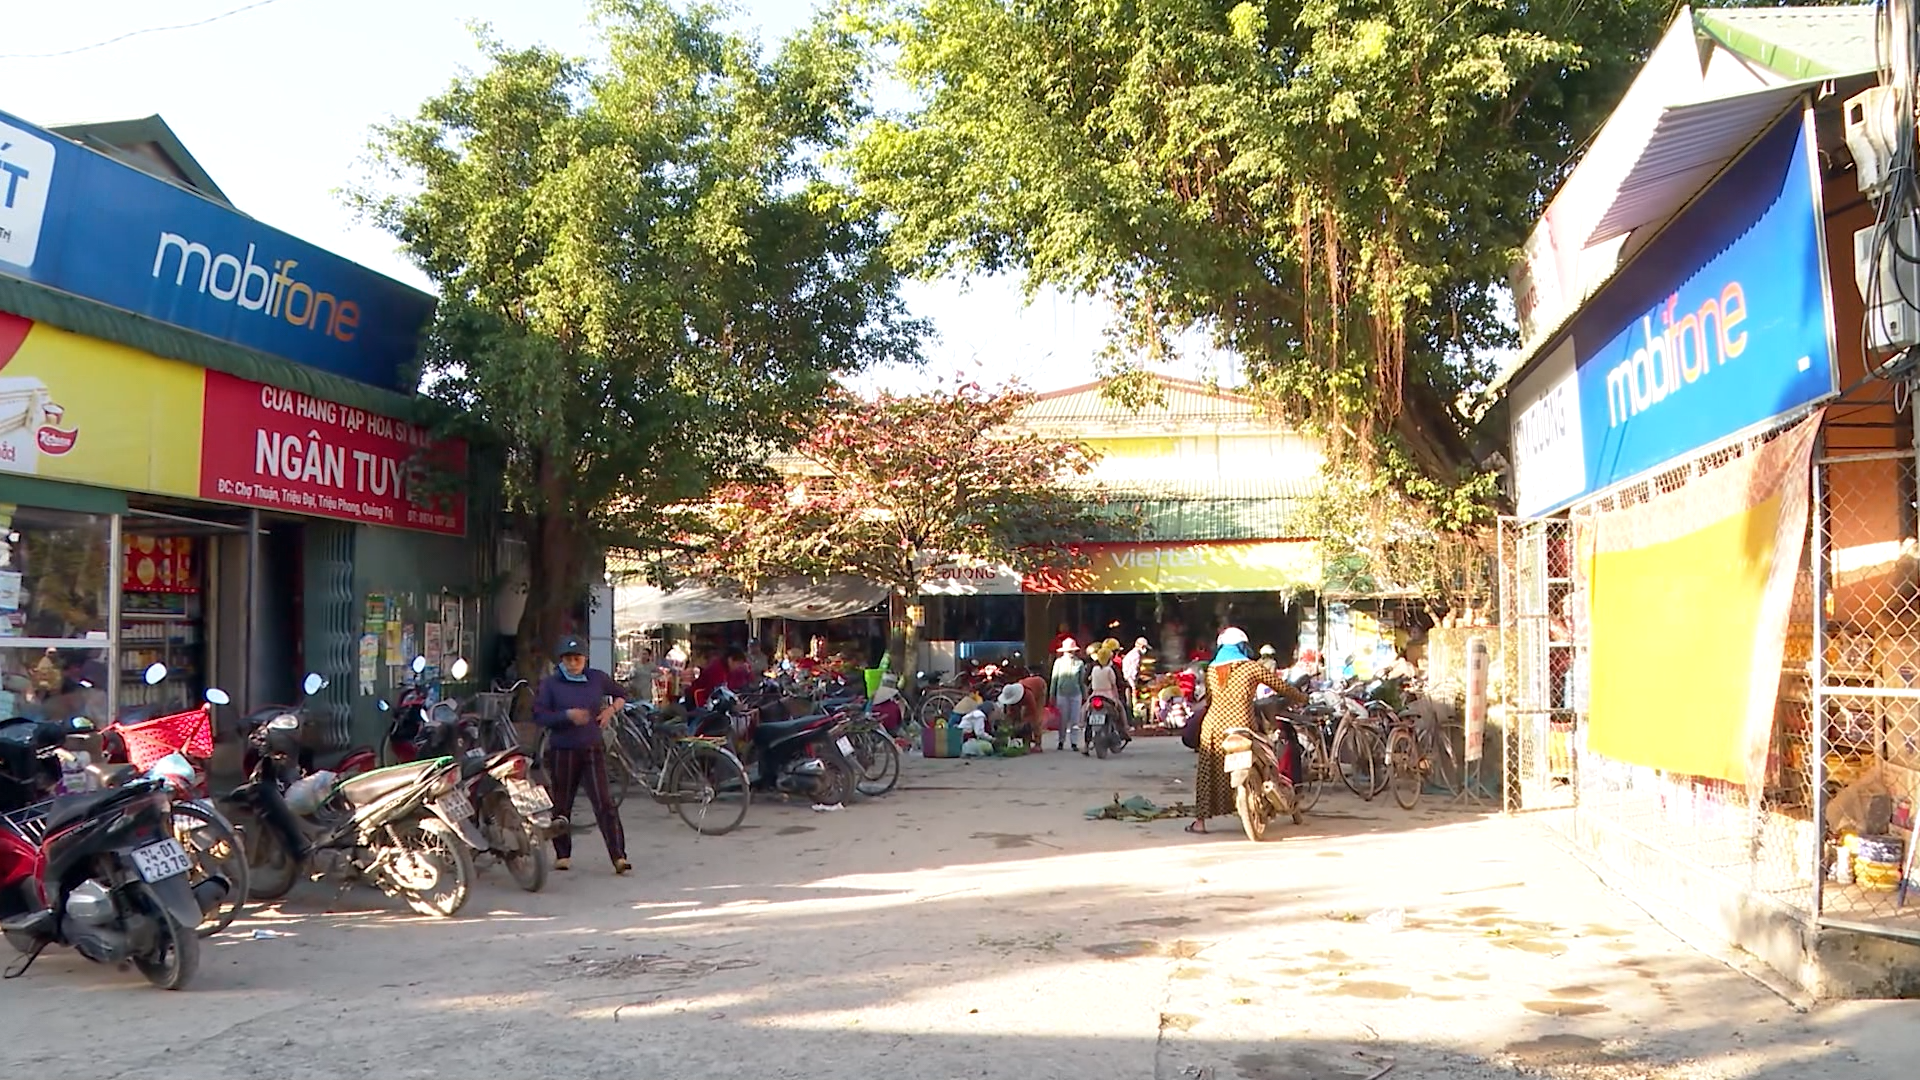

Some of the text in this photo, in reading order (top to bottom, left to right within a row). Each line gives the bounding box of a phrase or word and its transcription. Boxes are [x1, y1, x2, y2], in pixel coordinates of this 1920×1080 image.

[152, 231, 360, 342] mobifone
[1606, 281, 1749, 429] mobifone
[339, 405, 364, 434] TẠP
[218, 478, 234, 494] ĐC:
[235, 481, 252, 499] Chợ
[255, 429, 345, 489] NGÂN
